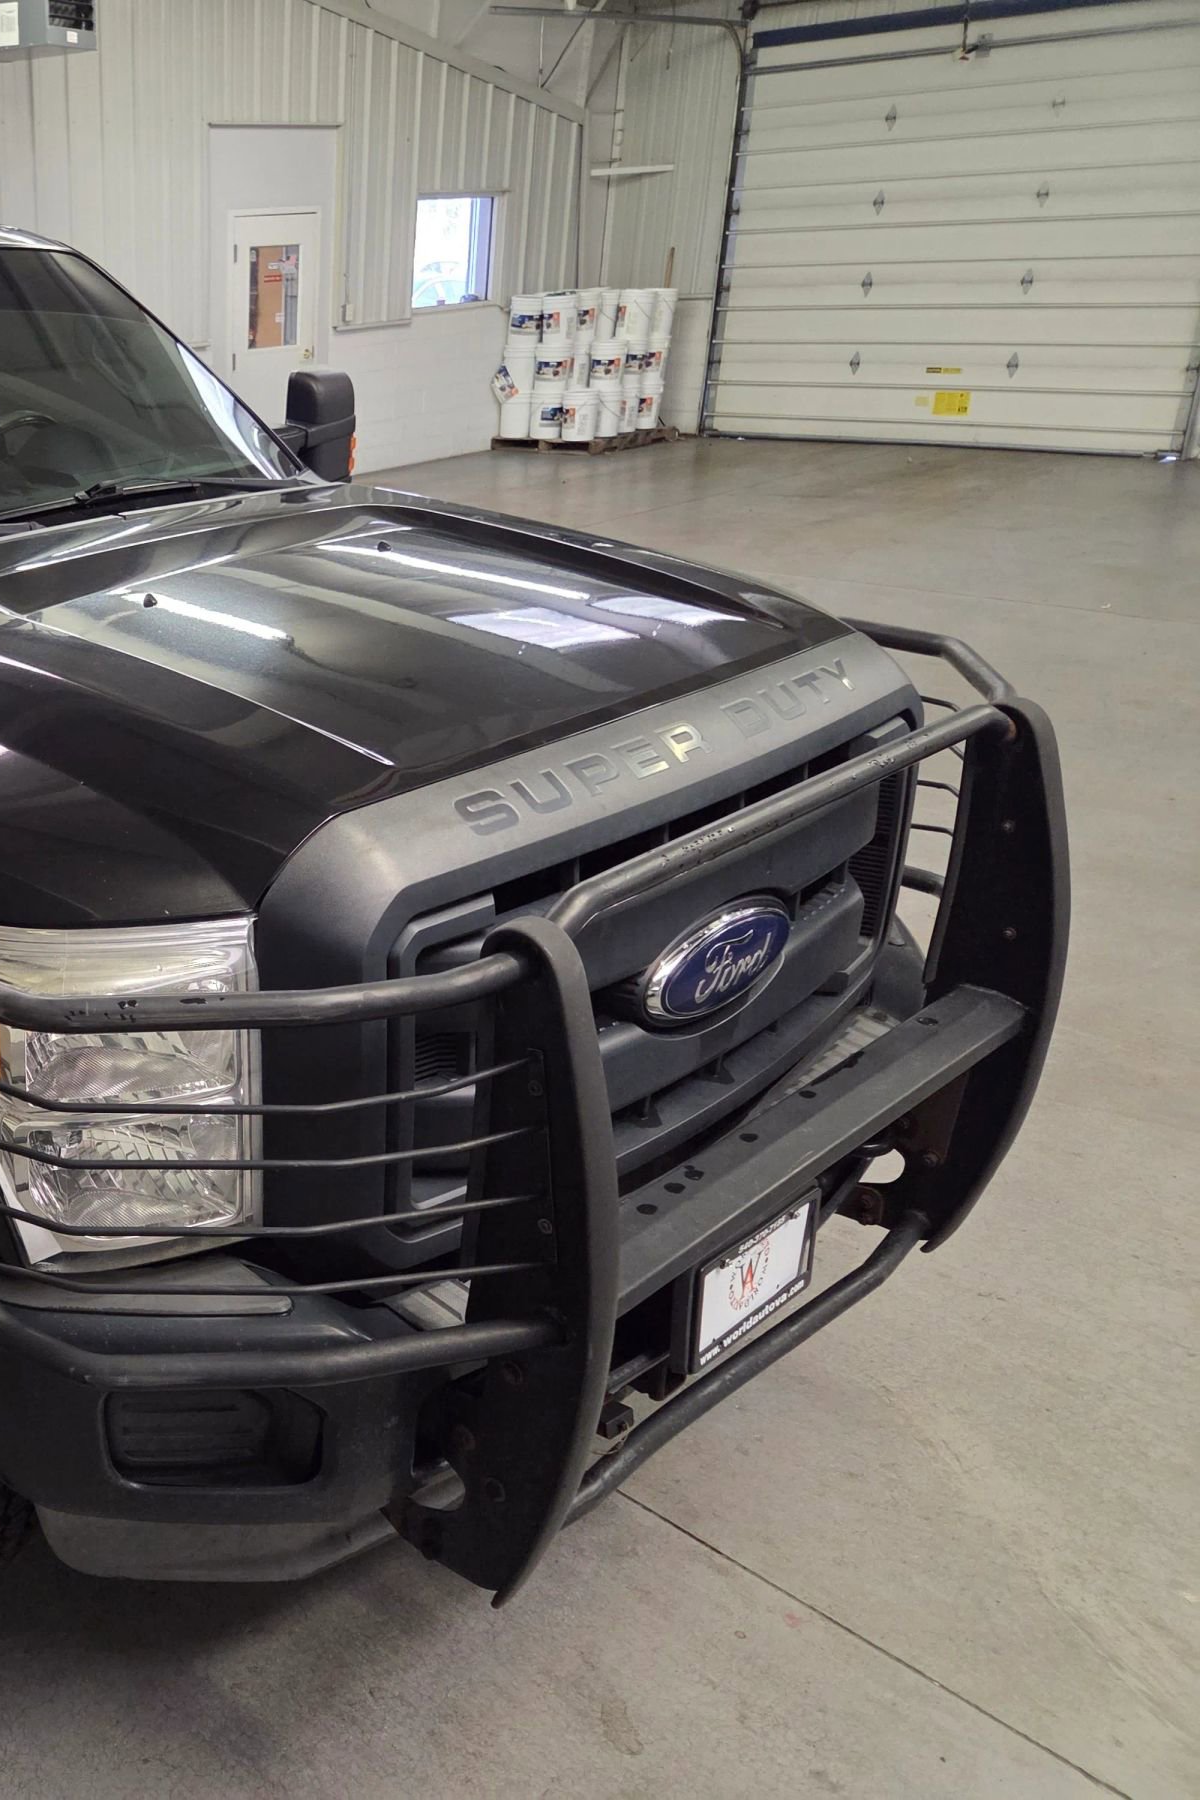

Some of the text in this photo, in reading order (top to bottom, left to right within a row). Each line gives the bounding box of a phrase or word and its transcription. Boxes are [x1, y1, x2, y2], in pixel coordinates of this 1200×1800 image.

[454, 657, 857, 837] SUPER DUTY
[694, 928, 773, 1004] Ford
